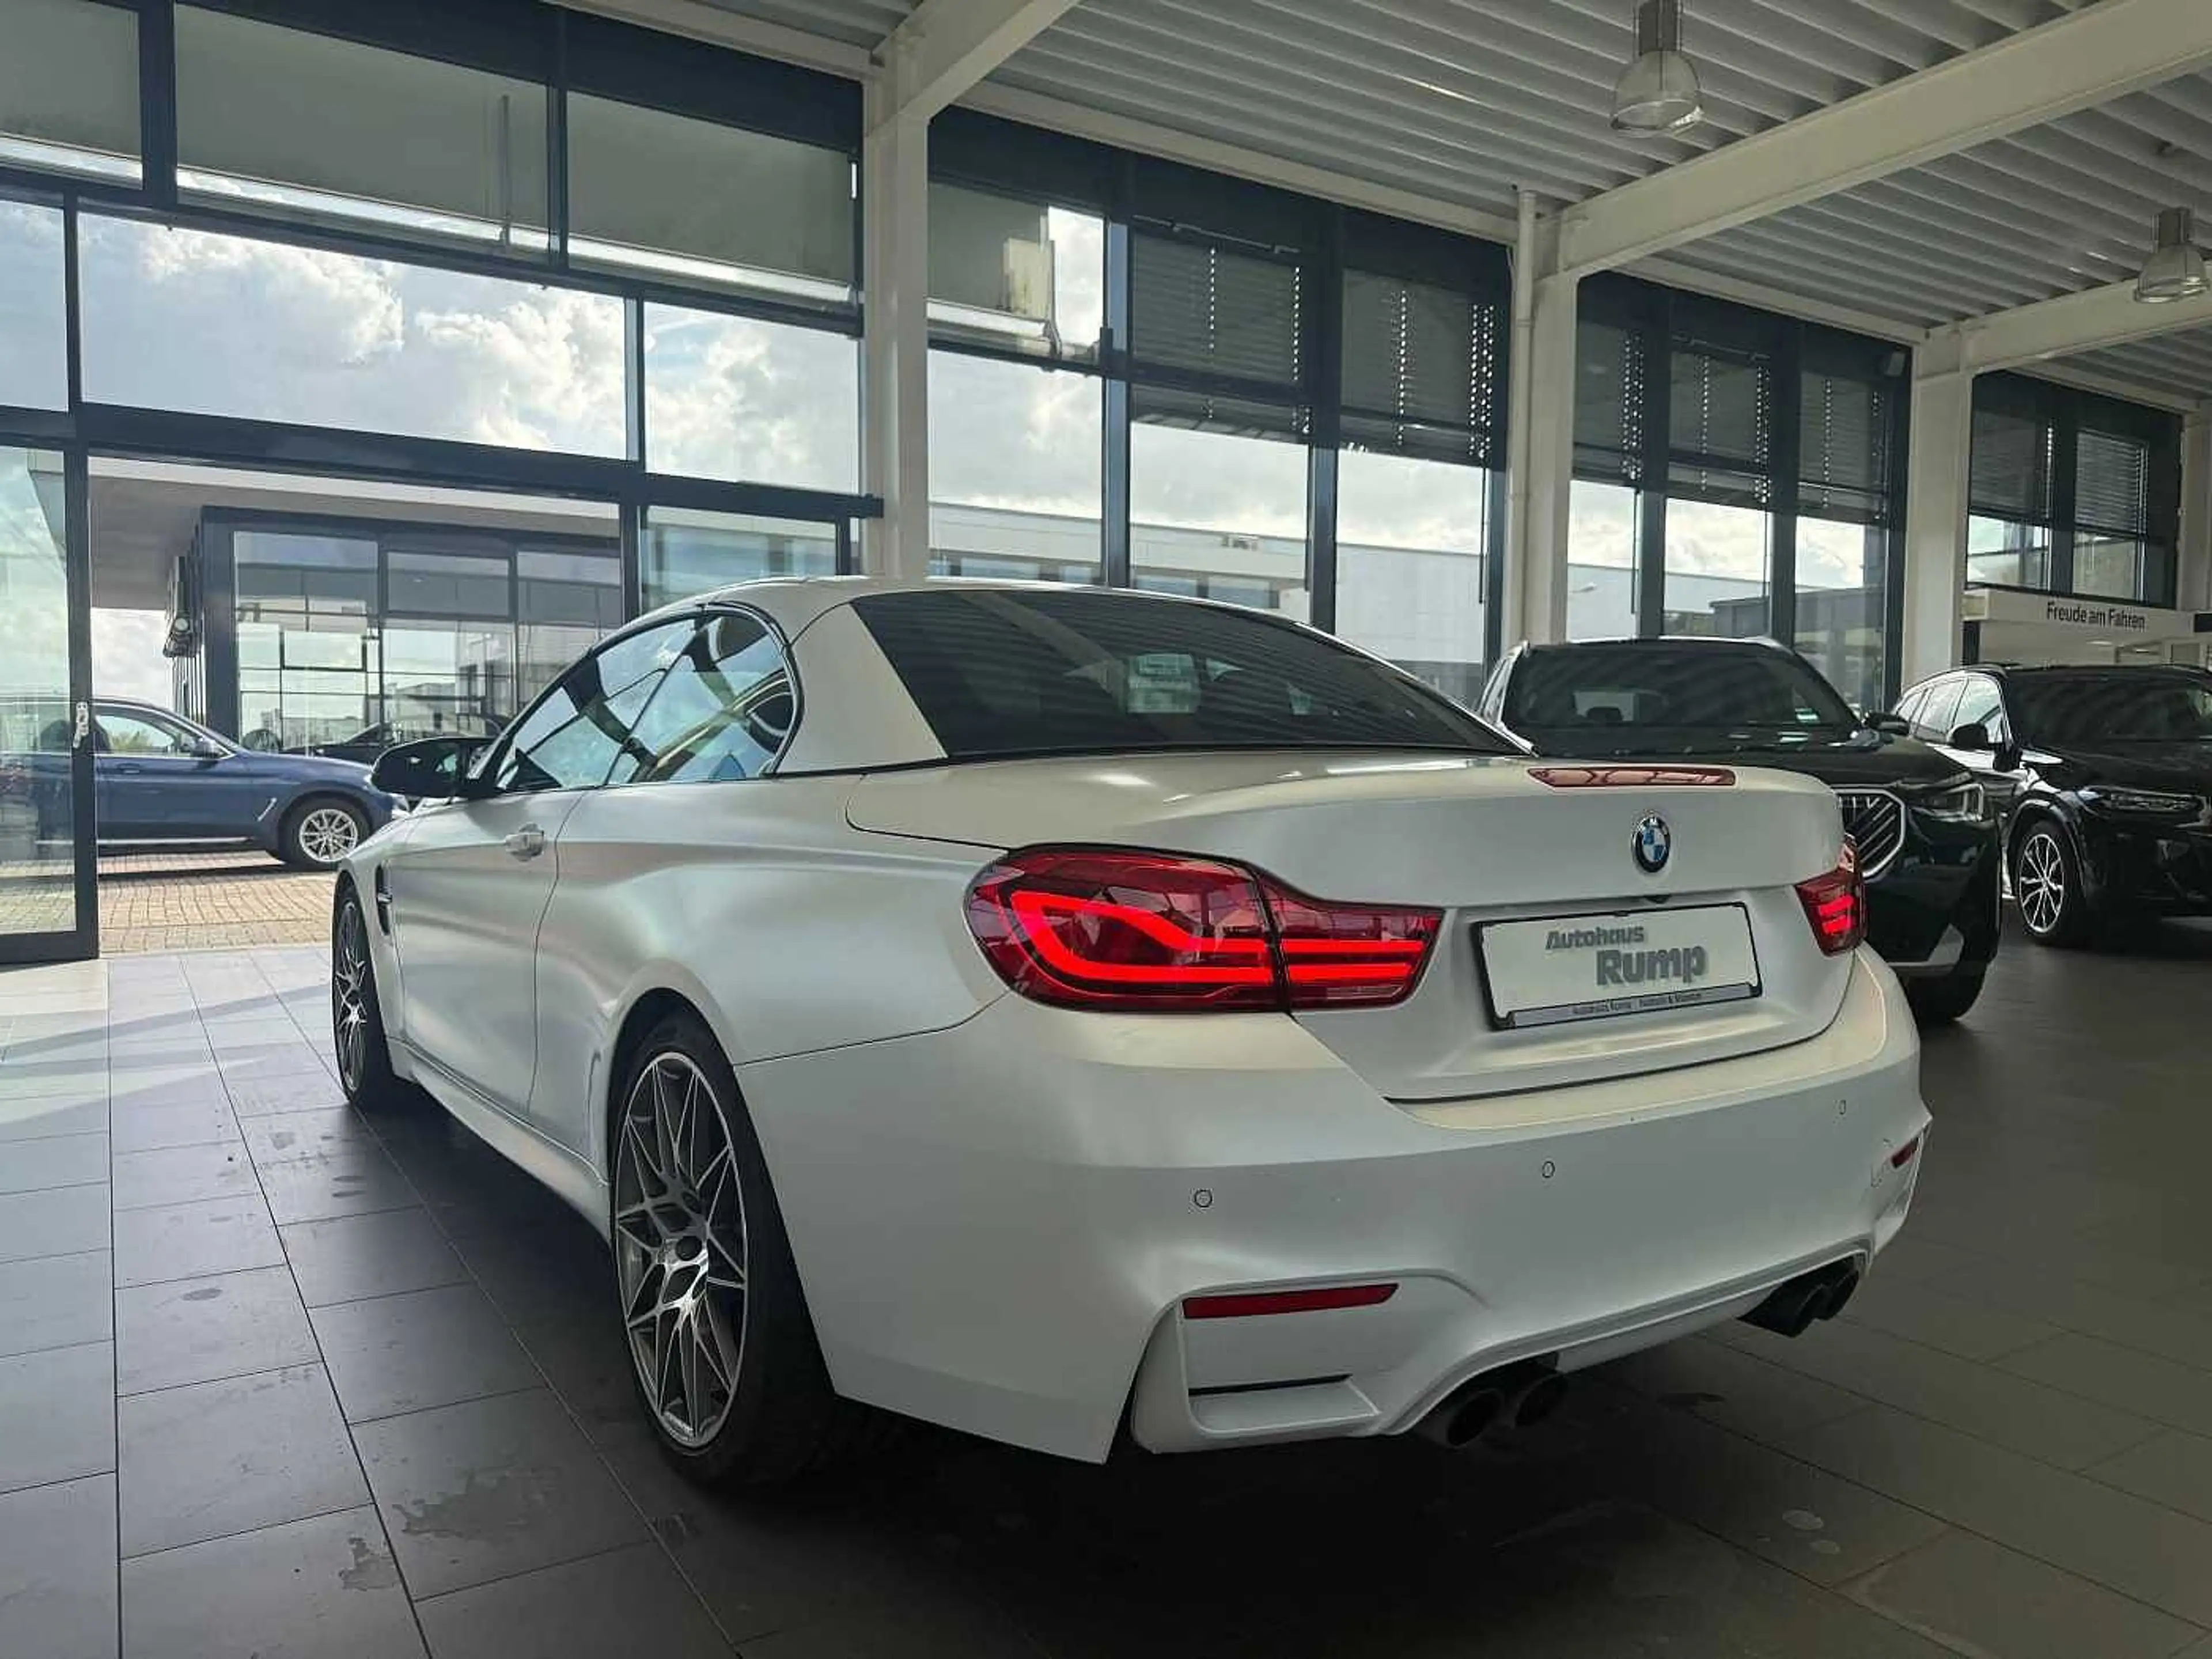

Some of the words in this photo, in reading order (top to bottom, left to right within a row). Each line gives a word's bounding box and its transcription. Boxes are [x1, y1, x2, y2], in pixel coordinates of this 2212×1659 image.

[2047, 601, 2086, 623] Freude
[2088, 611, 2105, 627] am
[2109, 608, 2145, 632] Fahren
[1545, 926, 1645, 950] Autohaus
[1596, 946, 1707, 986] Rump
